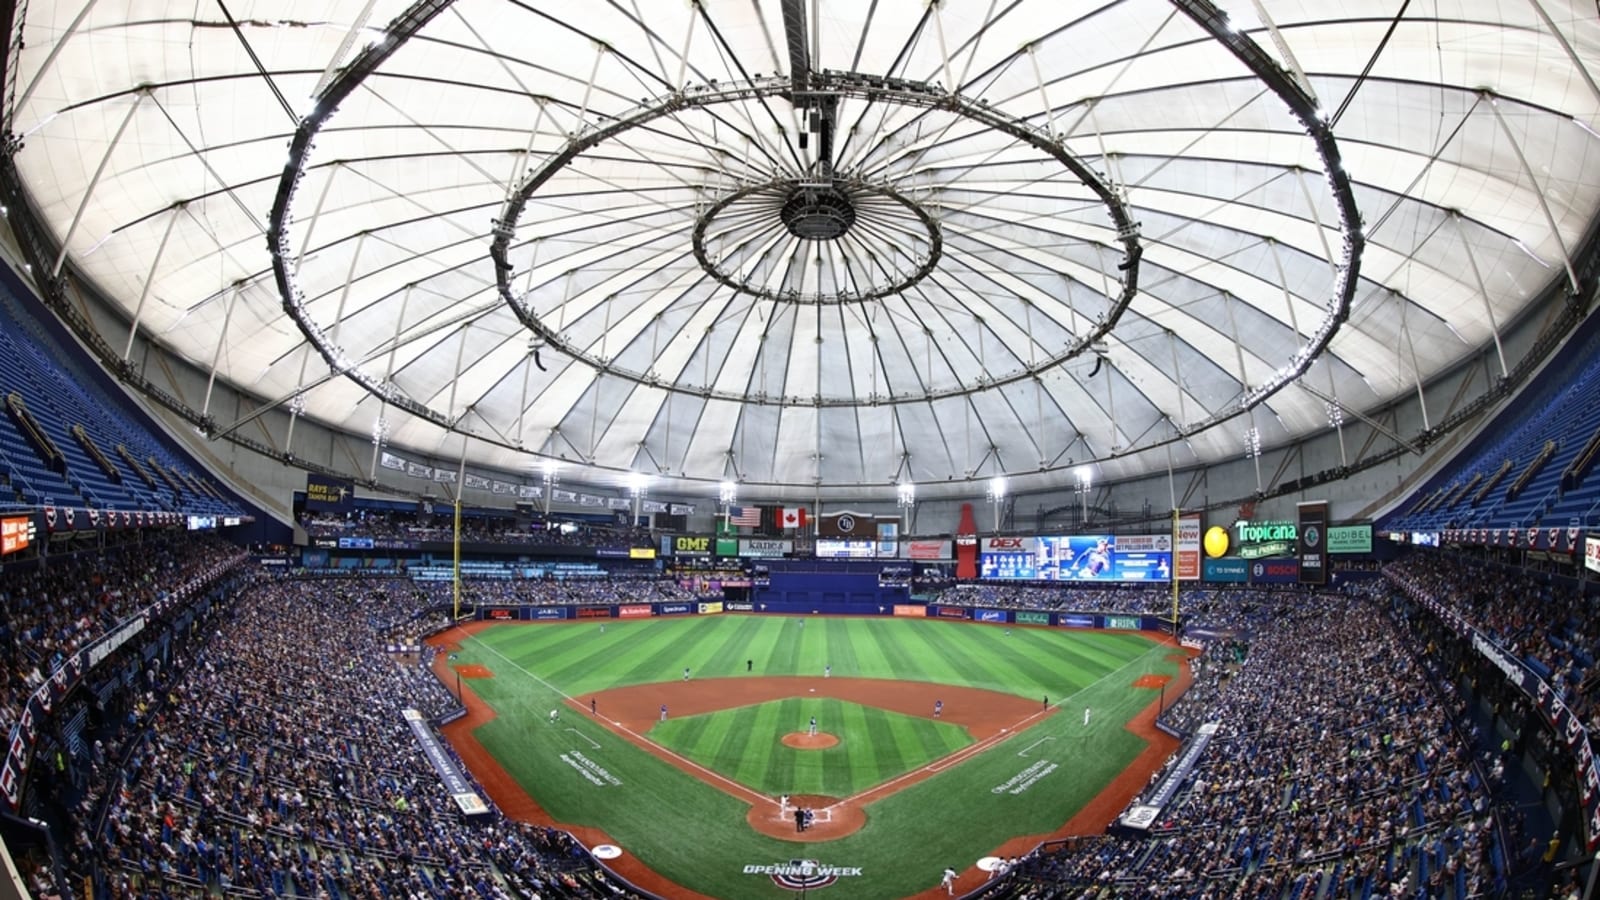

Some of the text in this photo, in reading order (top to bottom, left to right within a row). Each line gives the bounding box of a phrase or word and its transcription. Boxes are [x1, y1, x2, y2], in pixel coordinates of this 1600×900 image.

[309, 484, 328, 493] RAYS
[1235, 521, 1296, 543] Tropicana
[1328, 530, 1371, 540] AUDIBEL
[676, 537, 709, 551] GMF
[989, 537, 1022, 548] DEX
[1267, 565, 1298, 576] BOSCH
[537, 607, 559, 615] JABIL
[447, 775, 467, 793] FIELD
[1148, 778, 1177, 806] WELCOME
[743, 864, 863, 876] OPENING WEEK
